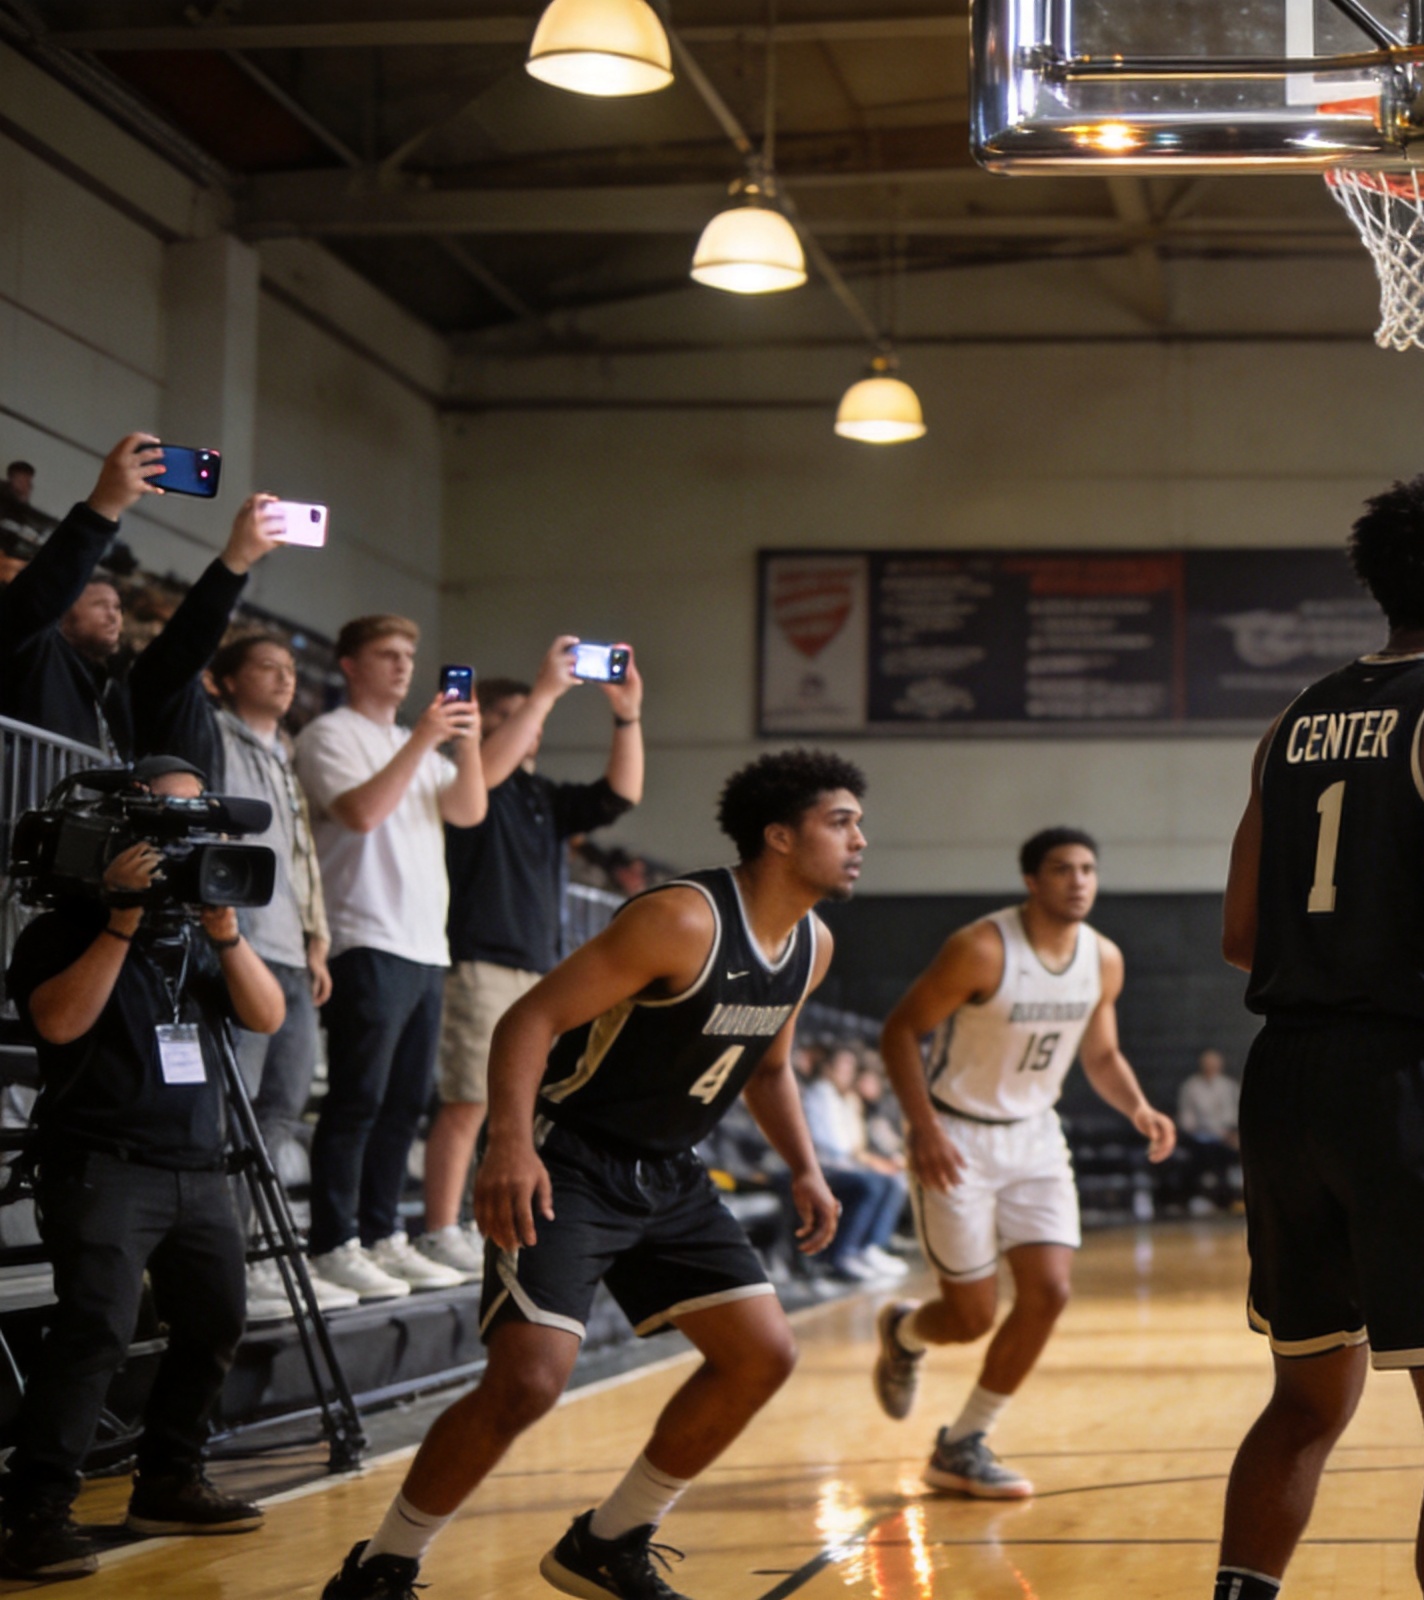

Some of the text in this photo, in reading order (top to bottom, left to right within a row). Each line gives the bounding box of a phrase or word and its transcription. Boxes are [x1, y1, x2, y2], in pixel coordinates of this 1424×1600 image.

[1286, 709, 1399, 764] CENTER
[1307, 780, 1346, 913] 1
[689, 1045, 745, 1104] 4
